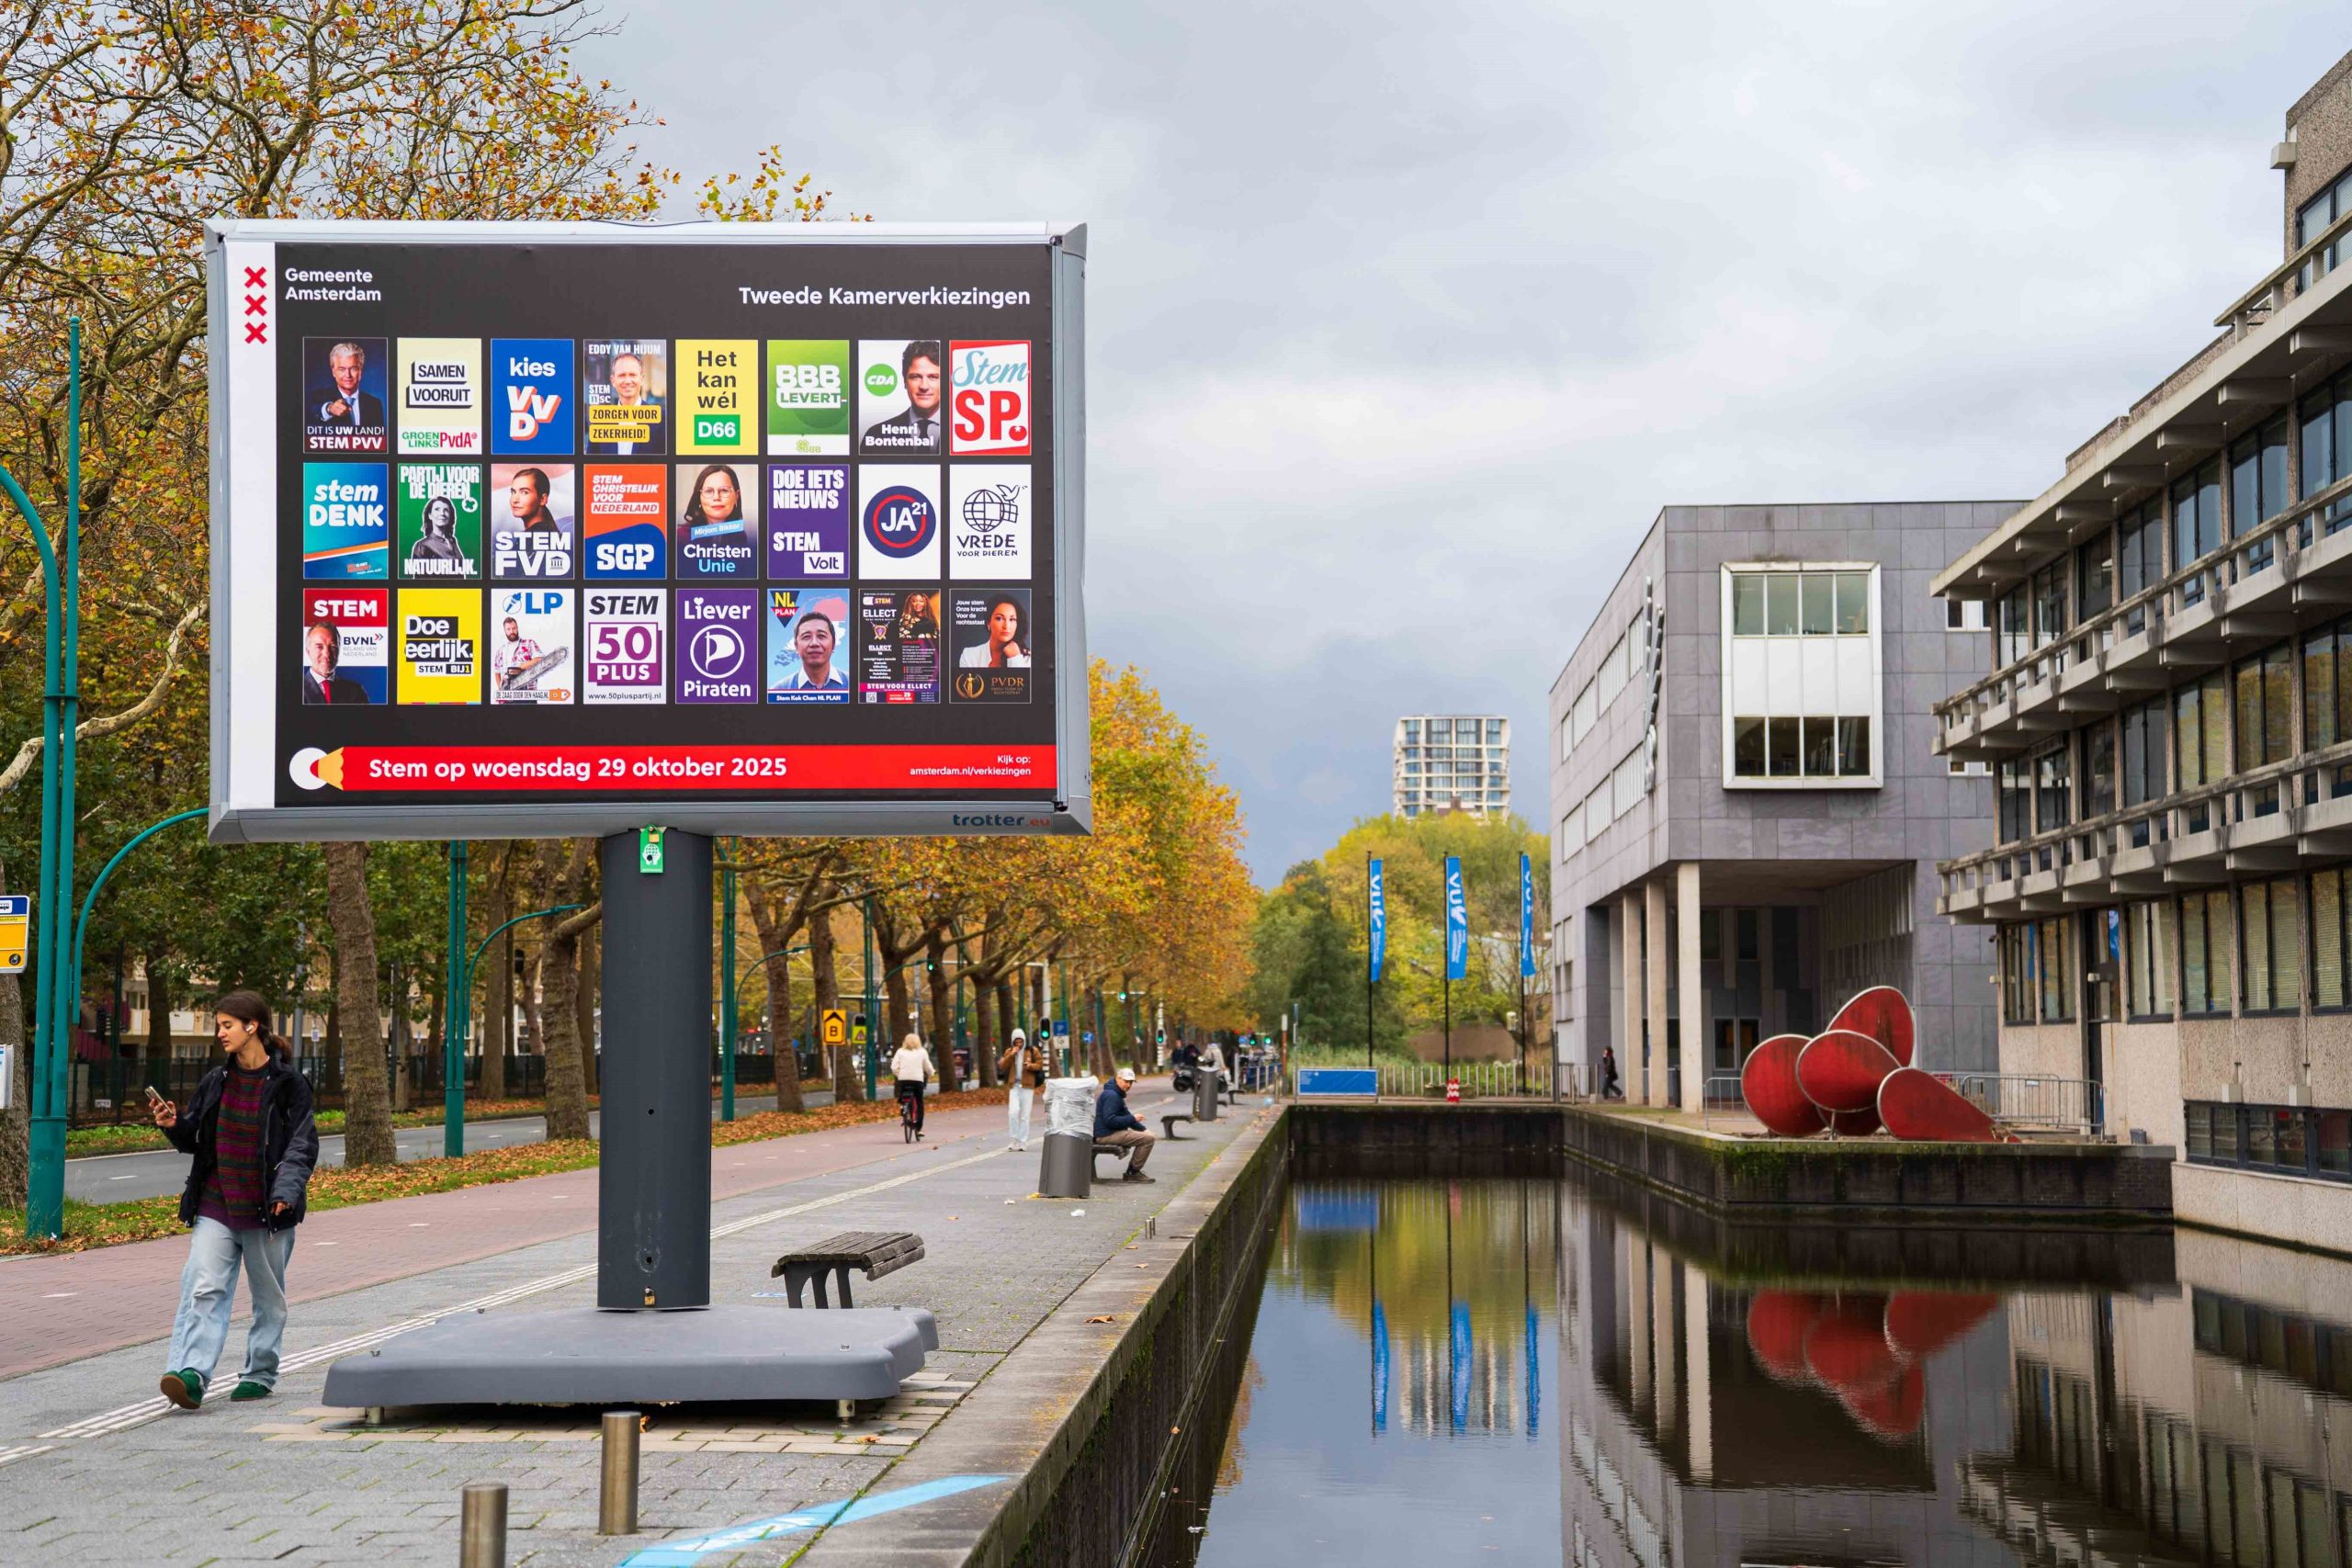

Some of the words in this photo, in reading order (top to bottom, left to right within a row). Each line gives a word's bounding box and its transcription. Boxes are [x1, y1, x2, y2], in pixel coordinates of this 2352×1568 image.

[285, 267, 373, 282] Gemeente
[285, 286, 381, 301] Amsterdam
[739, 286, 822, 305] Tweede
[829, 286, 1030, 310] Kamerverkiezingen
[588, 344, 611, 355] EDDY
[613, 344, 631, 355] VAN
[697, 350, 737, 367] Het
[418, 364, 465, 378] SAMEN
[509, 356, 556, 378] kies
[951, 350, 1030, 388] Stem
[697, 371, 737, 388] kan
[775, 365, 841, 389] BBB
[866, 375, 895, 386] CDA
[413, 388, 470, 401] VOORUIT
[588, 384, 611, 394] STEM
[697, 391, 737, 409] wél
[593, 409, 629, 420] ZORGEN
[631, 409, 658, 420] VOOR
[307, 425, 322, 435] DIT
[325, 425, 334, 435] IS
[335, 425, 354, 435] UW
[355, 425, 384, 435] LAND!
[593, 428, 646, 439] ZEKERHEID!
[697, 421, 736, 438] D66
[881, 423, 918, 435] Henri
[310, 436, 349, 449] STEM
[352, 436, 382, 449] PVV
[401, 432, 439, 440] GROEN
[439, 432, 472, 448] PvdA
[408, 440, 439, 448] LINKS
[865, 435, 934, 446] Bontenbal
[400, 466, 445, 483] PARTIJ
[446, 466, 480, 483] VOOR
[593, 475, 623, 484] STEM
[773, 468, 805, 490] DOE
[808, 468, 844, 490] IETS
[313, 479, 379, 502] stem
[409, 482, 426, 499] DE
[427, 482, 470, 499] DIEREN
[593, 484, 659, 493] CHRISTELIJK
[593, 493, 623, 502] VOOR
[773, 490, 839, 510] NIEUWS
[309, 504, 384, 527] DENK
[593, 503, 658, 513] NEDERLAND
[495, 531, 571, 551] STEM
[773, 531, 820, 552] STEM
[956, 535, 1016, 548] VREDE
[596, 544, 655, 571] SGP
[683, 543, 752, 558] Christen
[494, 550, 571, 576] FVD
[698, 558, 736, 573] Unie
[808, 556, 840, 570] Volt
[525, 592, 563, 615] LP
[588, 595, 659, 615] STEM
[775, 592, 796, 607] NL
[313, 600, 378, 617] STEM
[684, 597, 752, 620] Liever
[863, 608, 898, 618] ELLECT
[405, 615, 450, 636] Doe
[343, 637, 377, 646] BVNL
[595, 626, 652, 661] 50
[404, 638, 473, 663] eerlijk.
[418, 664, 444, 673] STEM
[450, 664, 470, 673] BIJ1
[597, 664, 650, 681] PLUS
[684, 680, 752, 697] Piraten
[991, 677, 1024, 687] PVDR
[588, 692, 662, 701] www.50pluspartij.nl
[997, 755, 1014, 764] Kijk
[1015, 756, 1031, 764] op:
[369, 758, 428, 778] Stem
[434, 761, 466, 782] op
[472, 757, 591, 782] woensdag
[597, 758, 626, 777] 29
[632, 756, 725, 777] oktober
[730, 758, 787, 777] 2025
[910, 766, 1031, 777] amsterdam.nl/verkiezingen
[1449, 871, 1463, 905] VU
[830, 1025, 838, 1037] B
